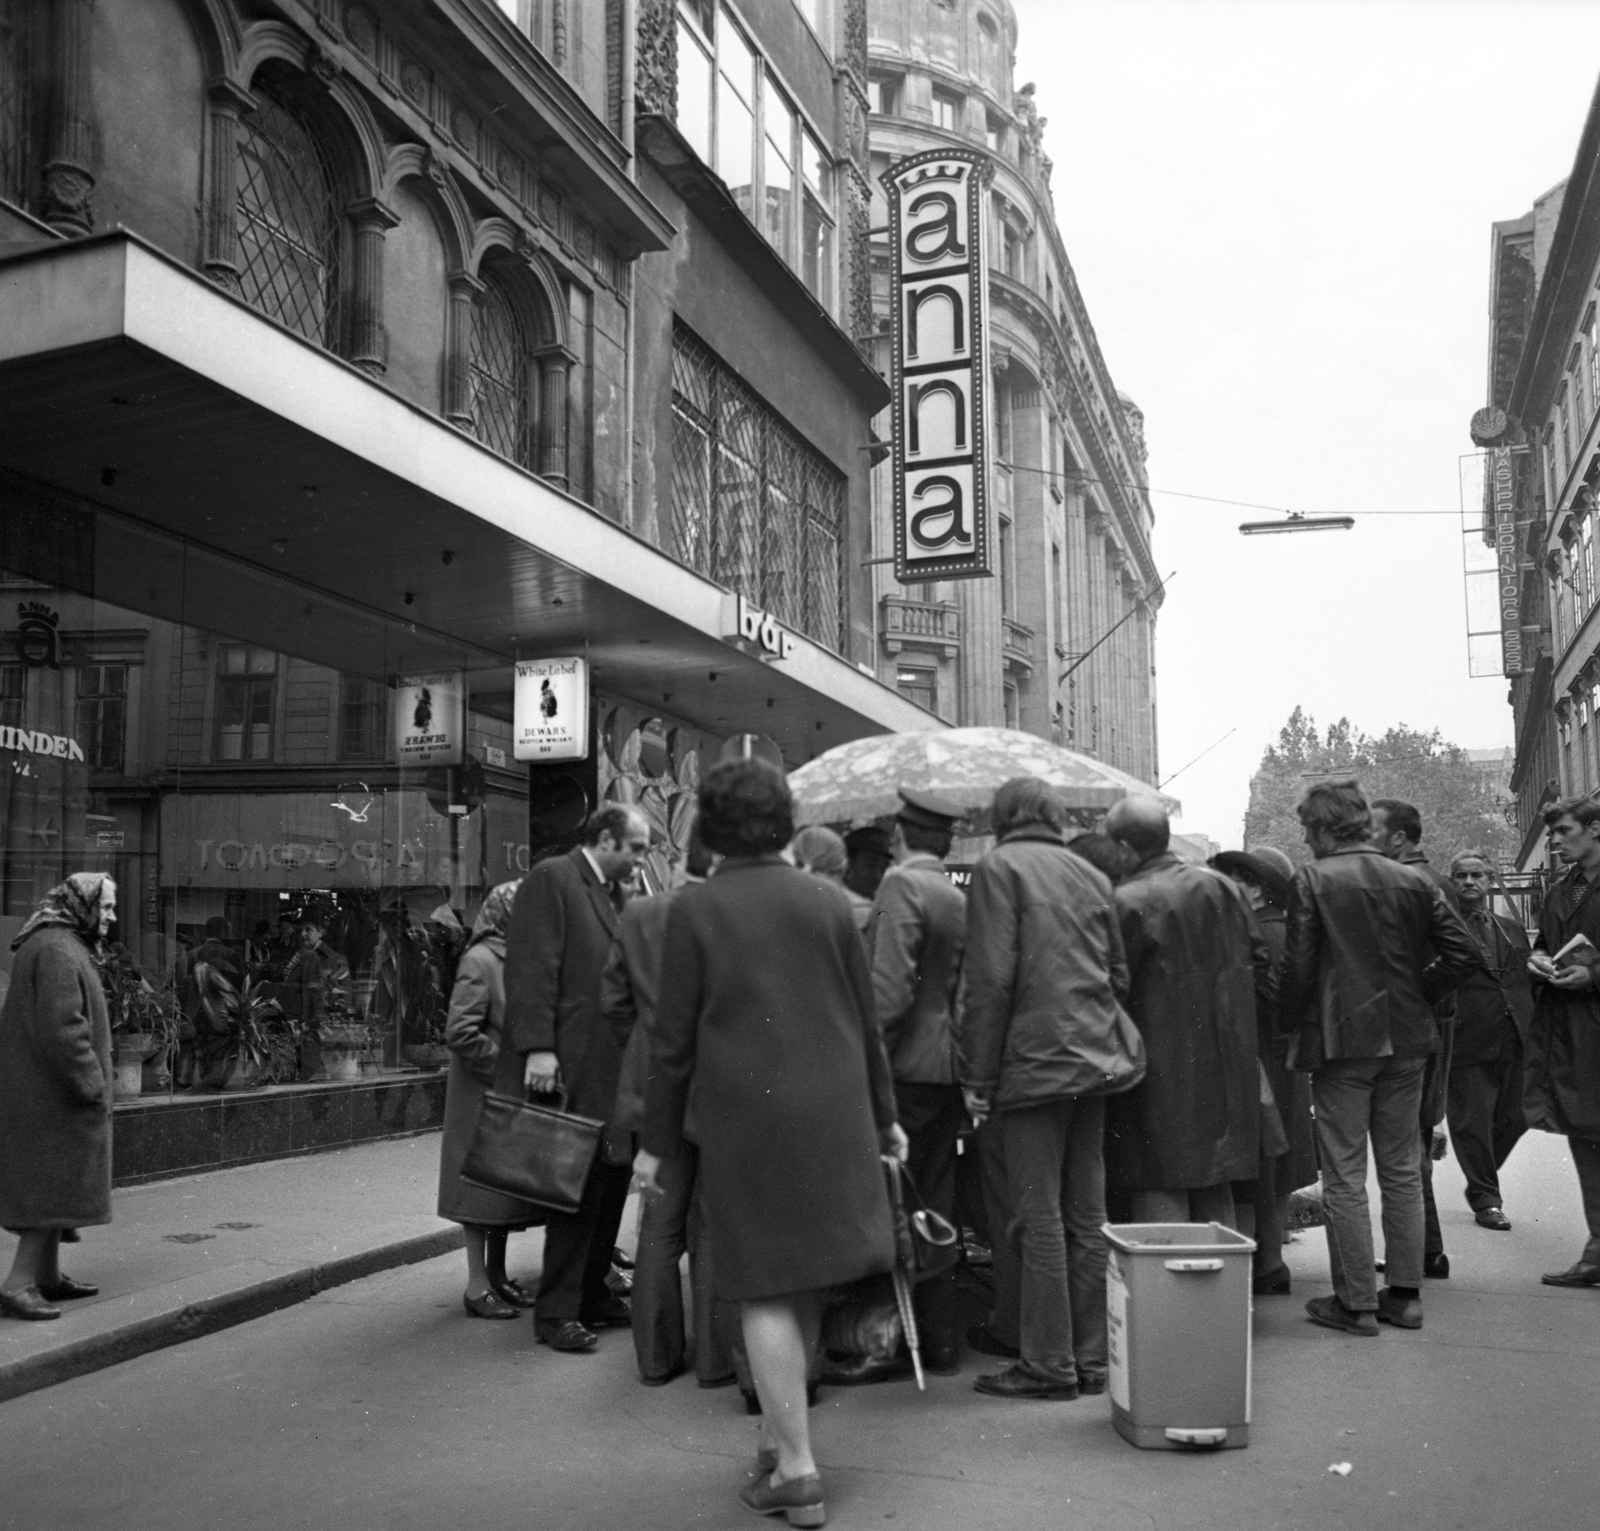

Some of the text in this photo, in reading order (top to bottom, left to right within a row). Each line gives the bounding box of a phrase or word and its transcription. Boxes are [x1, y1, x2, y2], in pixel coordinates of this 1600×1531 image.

[905, 190, 973, 549] anna
[17, 601, 59, 620] ANNA
[1493, 446, 1522, 673] MASHPRIBORINTORG SSSR
